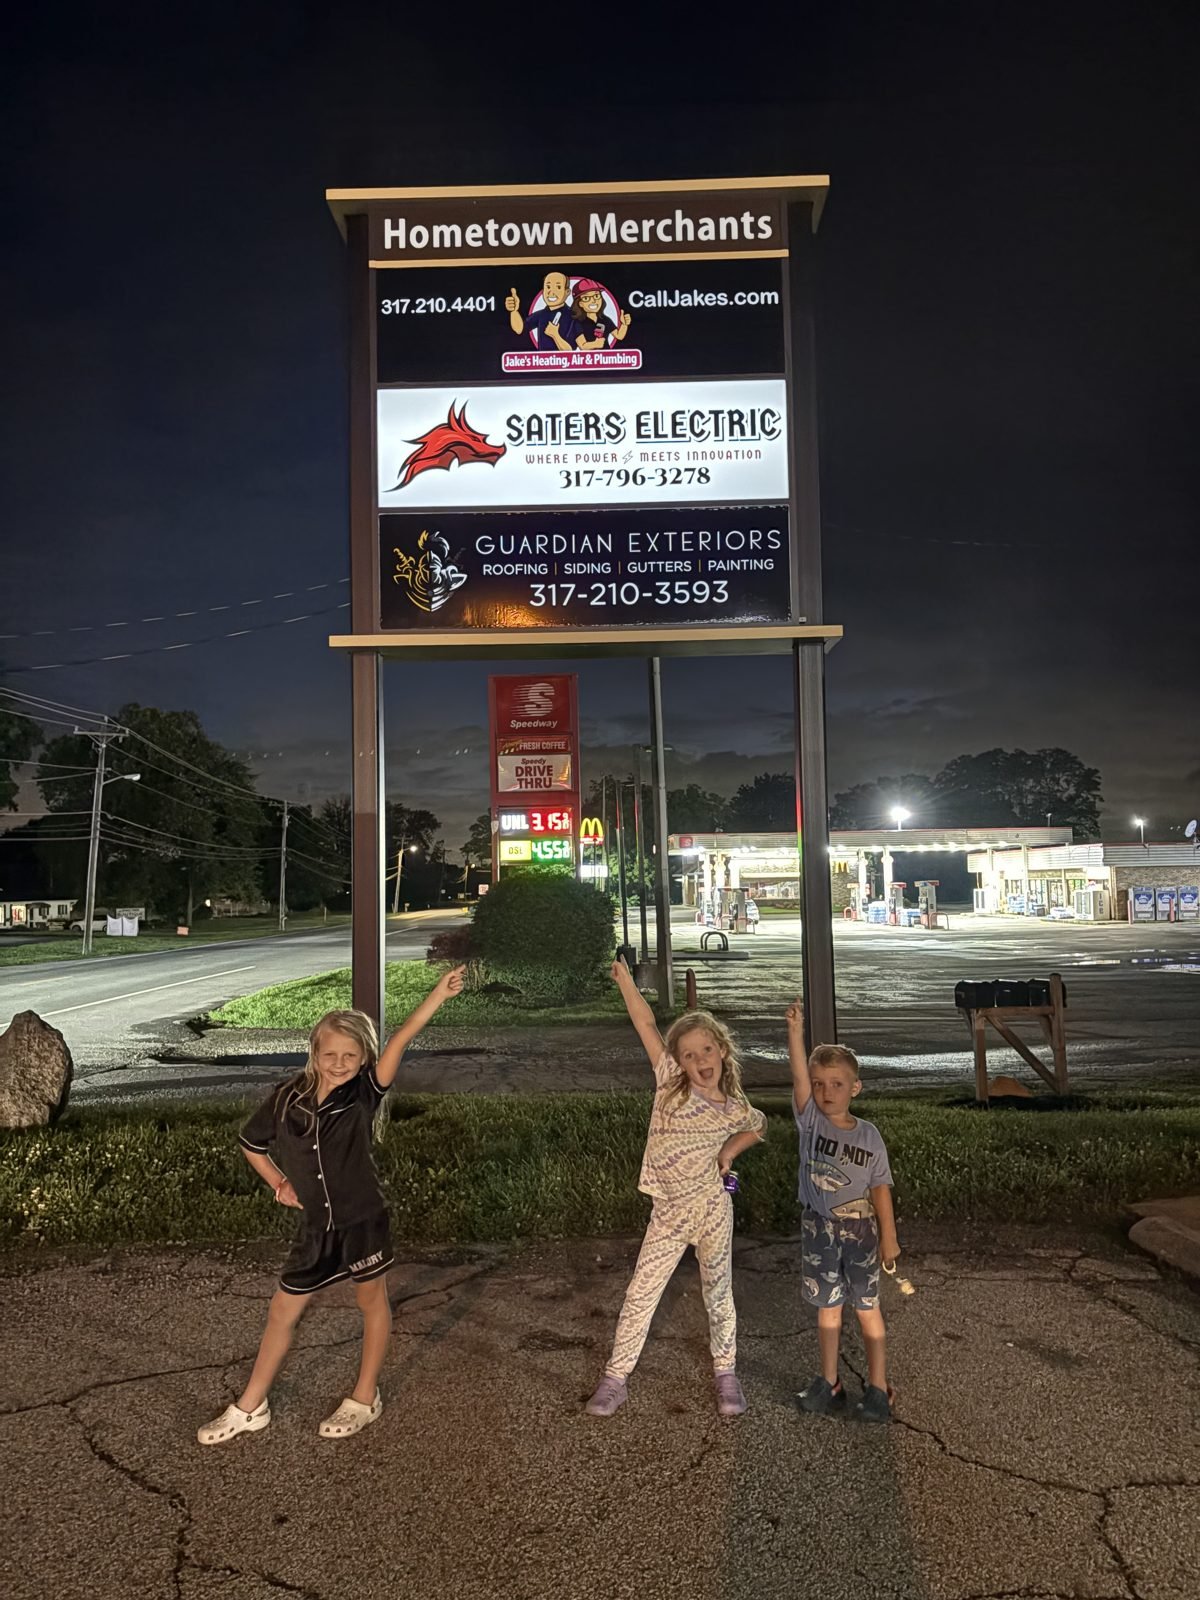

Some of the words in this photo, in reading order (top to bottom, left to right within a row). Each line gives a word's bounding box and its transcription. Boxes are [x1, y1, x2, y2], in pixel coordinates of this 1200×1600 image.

[384, 217, 573, 250] Hometown
[588, 210, 773, 244] Merchants
[381, 295, 496, 316] 317.210.4401
[628, 289, 779, 308] CallJakes.com
[505, 355, 531, 367] Jake's
[532, 355, 570, 368] Heating,
[571, 354, 584, 365] Air
[585, 354, 593, 365] &
[593, 353, 638, 366] Plumbing
[506, 411, 626, 446] SATERS
[635, 407, 782, 443] ELECTRIC
[525, 453, 569, 464] WHERE
[575, 452, 618, 463] POWER
[639, 451, 681, 462] MEETS
[687, 449, 762, 461] INNOVATION
[559, 467, 711, 489] 317-796-3278
[475, 532, 612, 555] GUARDIAN
[628, 529, 781, 553] EXTERIORS
[483, 563, 548, 576] ROOFING
[564, 562, 612, 574] SIDING
[627, 560, 692, 573] GUTTERS
[708, 558, 774, 571] PAINTING
[529, 580, 729, 607] 317-210-3593
[510, 719, 558, 729] Speedway
[519, 741, 540, 750] FRESH
[541, 741, 566, 749] COFFEE
[515, 765, 553, 777] DRIVE
[517, 777, 552, 789] THRU
[501, 814, 530, 830] UNL
[508, 846, 524, 855] DSL
[814, 1134, 838, 1158] DO
[840, 1143, 873, 1168] NOT
